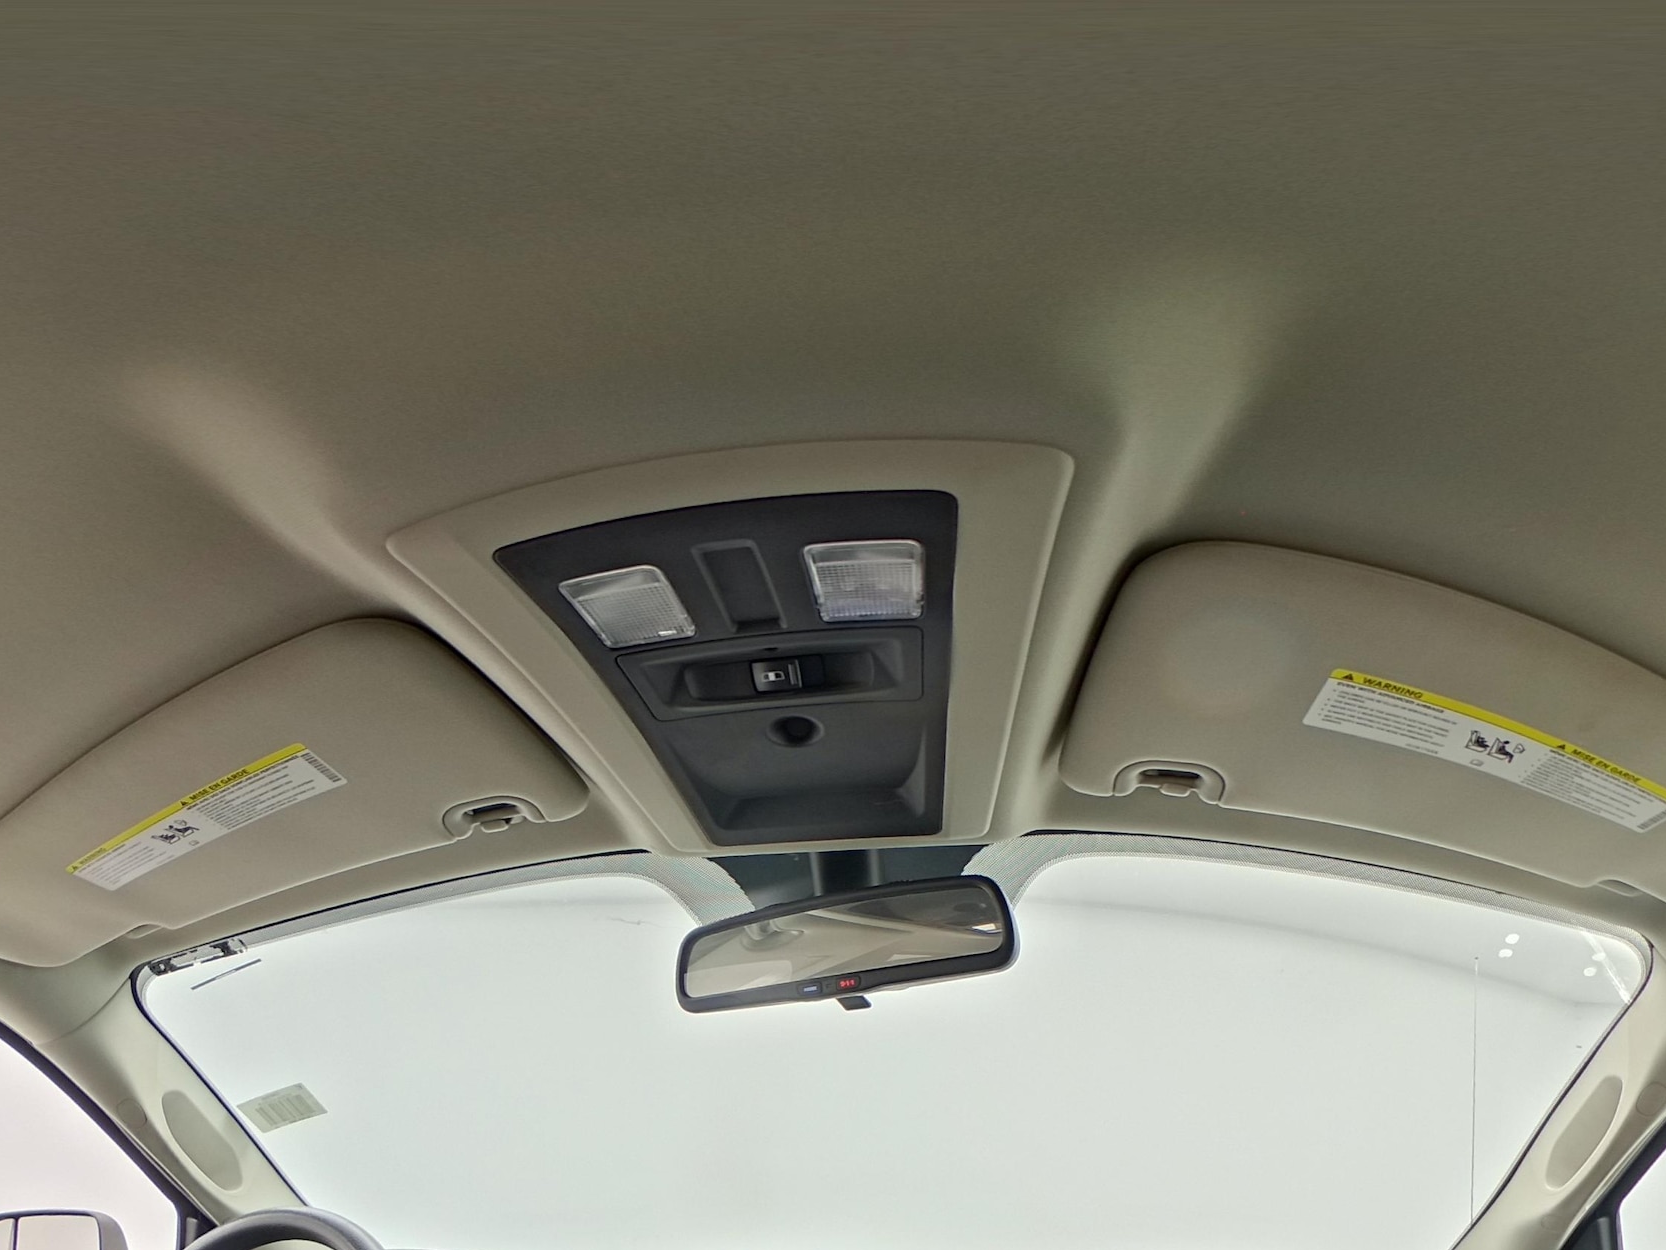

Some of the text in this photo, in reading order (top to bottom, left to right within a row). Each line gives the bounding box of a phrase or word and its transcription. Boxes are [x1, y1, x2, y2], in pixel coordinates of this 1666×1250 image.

[1362, 676, 1423, 700] WARNING
[1572, 749, 1641, 783] MISE EN GARDE
[189, 768, 250, 801] MISE EN GARDE
[839, 980, 855, 989] 911
